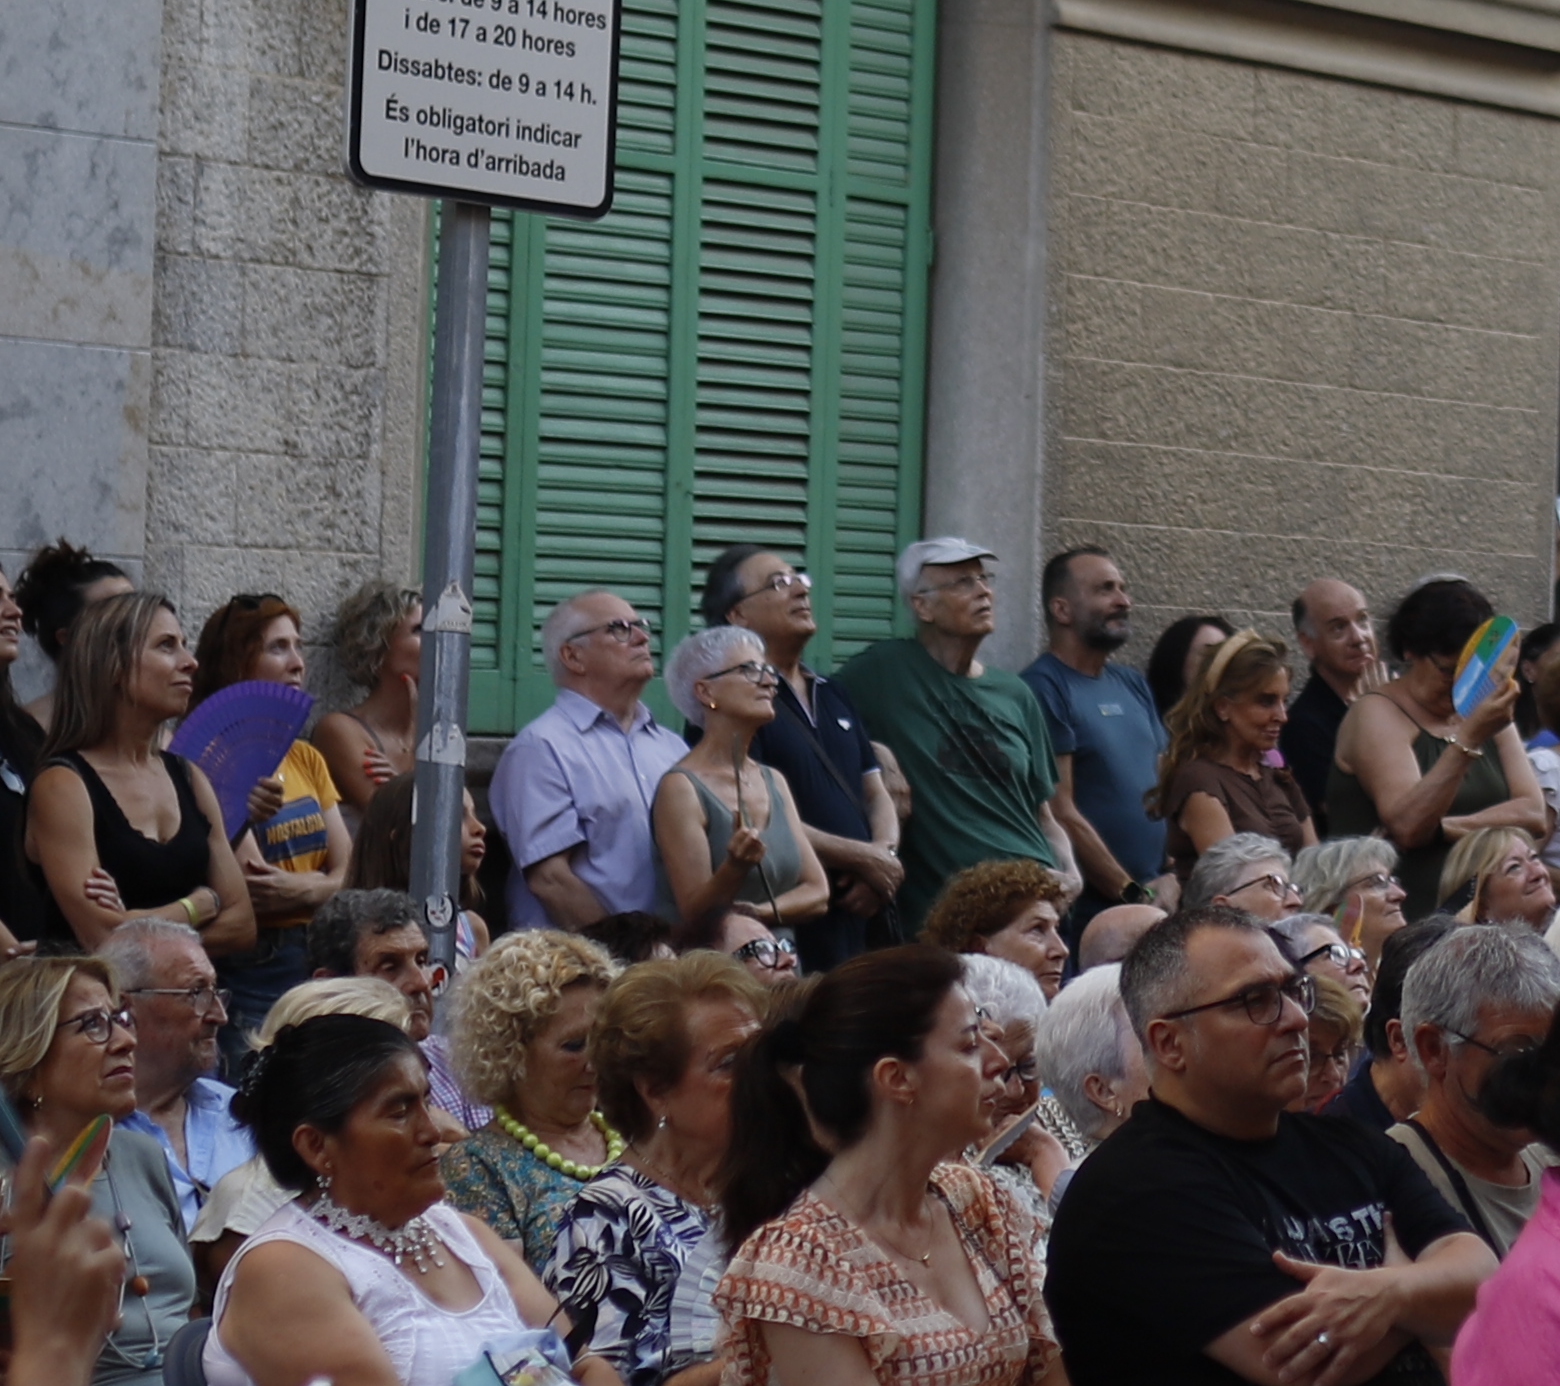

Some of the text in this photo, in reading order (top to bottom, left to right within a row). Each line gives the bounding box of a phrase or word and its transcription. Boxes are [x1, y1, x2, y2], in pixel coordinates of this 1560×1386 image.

[404, 7, 576, 58] i de 17 a 20 hores
[553, 0, 607, 31] hores
[377, 48, 597, 106] Dissabtes: de 9 a 14 h.
[385, 92, 583, 149] És obligatori indicar
